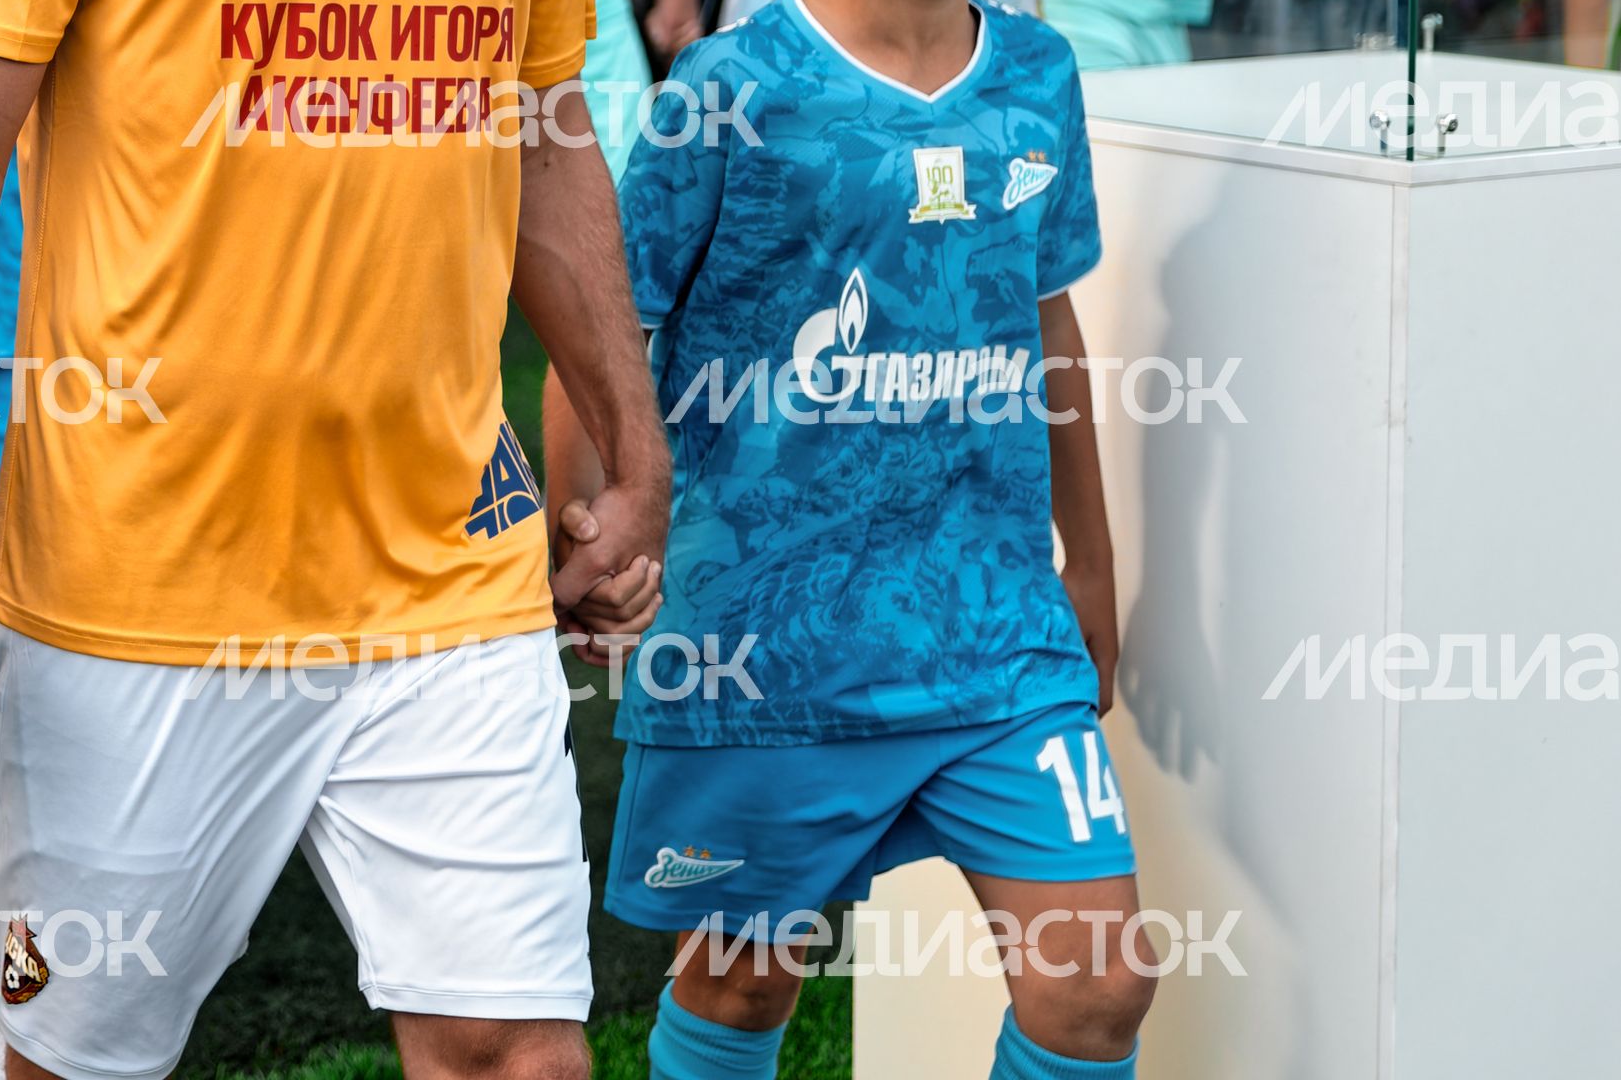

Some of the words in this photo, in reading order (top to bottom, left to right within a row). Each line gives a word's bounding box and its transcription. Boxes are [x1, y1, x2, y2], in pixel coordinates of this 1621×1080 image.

[221, 2, 378, 70] КУБОК
[390, 4, 514, 62] ИГОРЯ
[234, 73, 493, 136] АКИНФЕЕВА
[1035, 730, 1127, 843] 14
[5, 928, 42, 982] СКА
